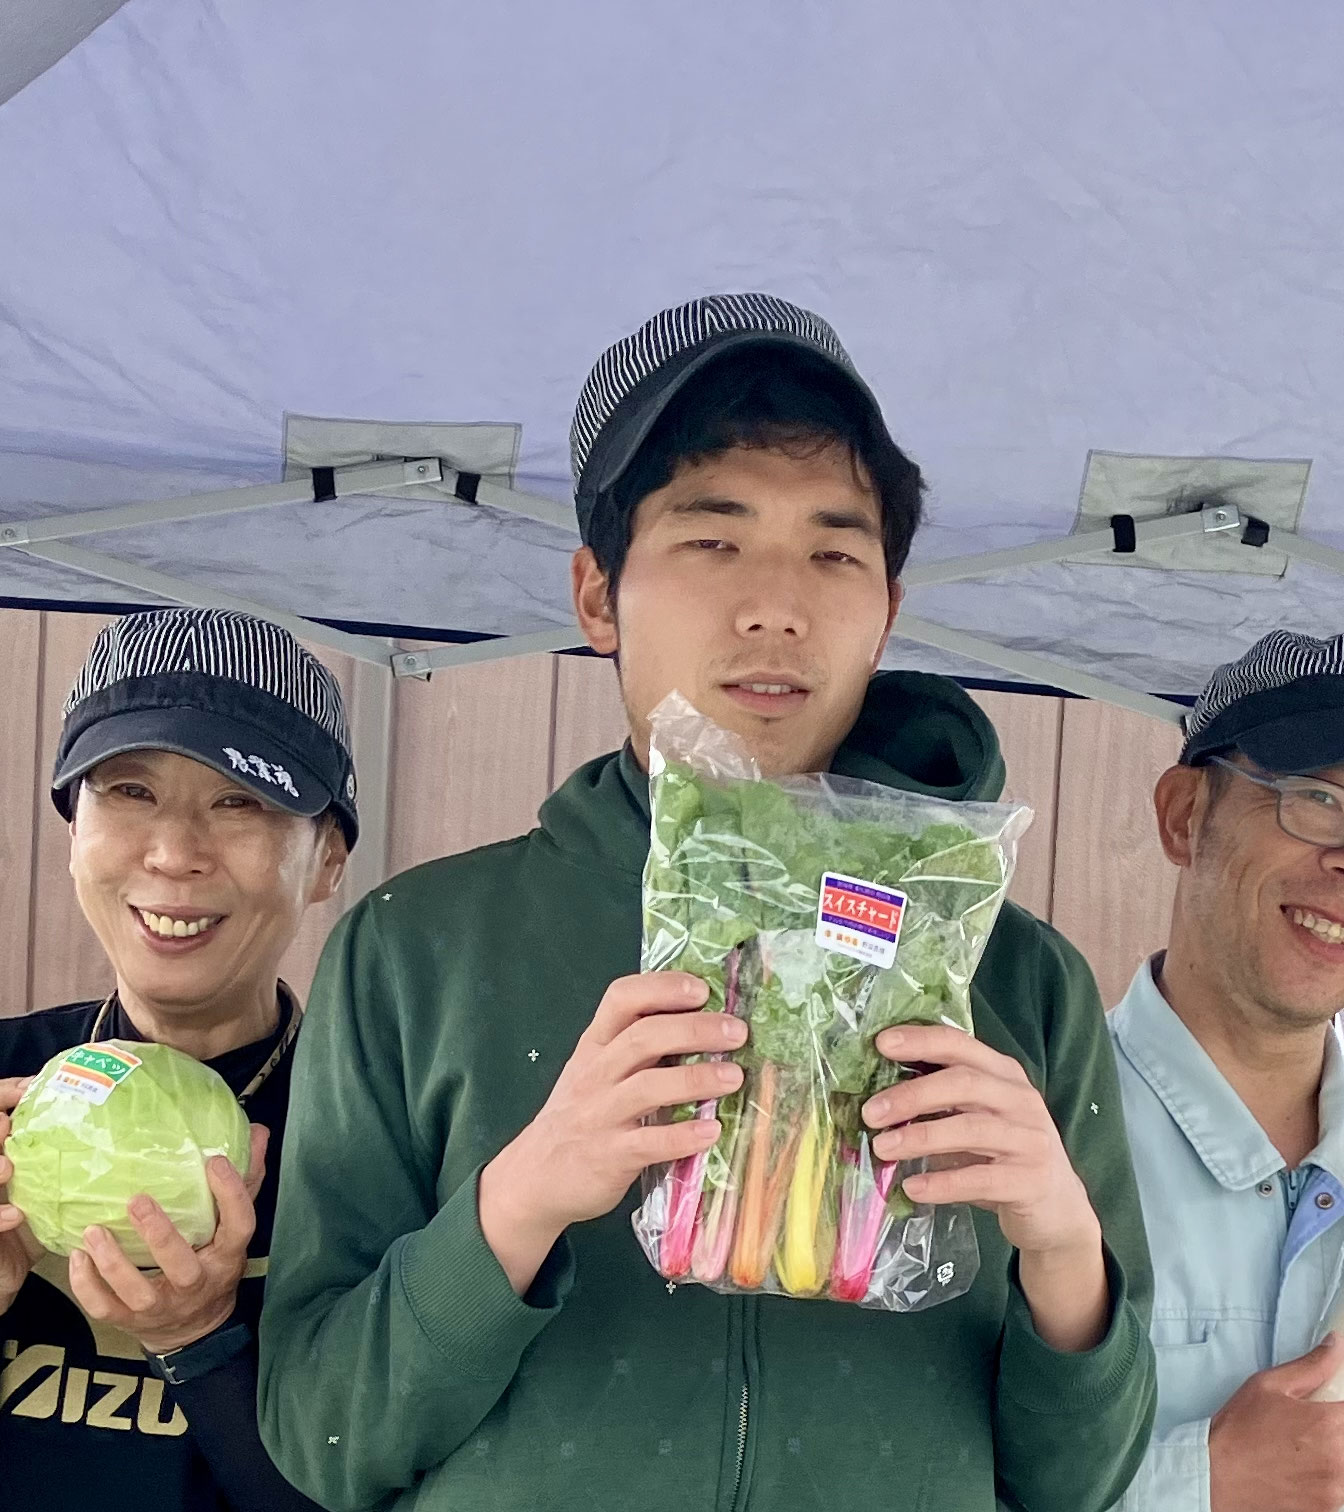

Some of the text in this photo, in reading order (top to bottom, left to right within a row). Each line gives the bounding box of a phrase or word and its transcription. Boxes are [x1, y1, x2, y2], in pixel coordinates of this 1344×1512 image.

[823, 893, 899, 929] スイスチャード
[69, 1050, 126, 1075] キャベツ
